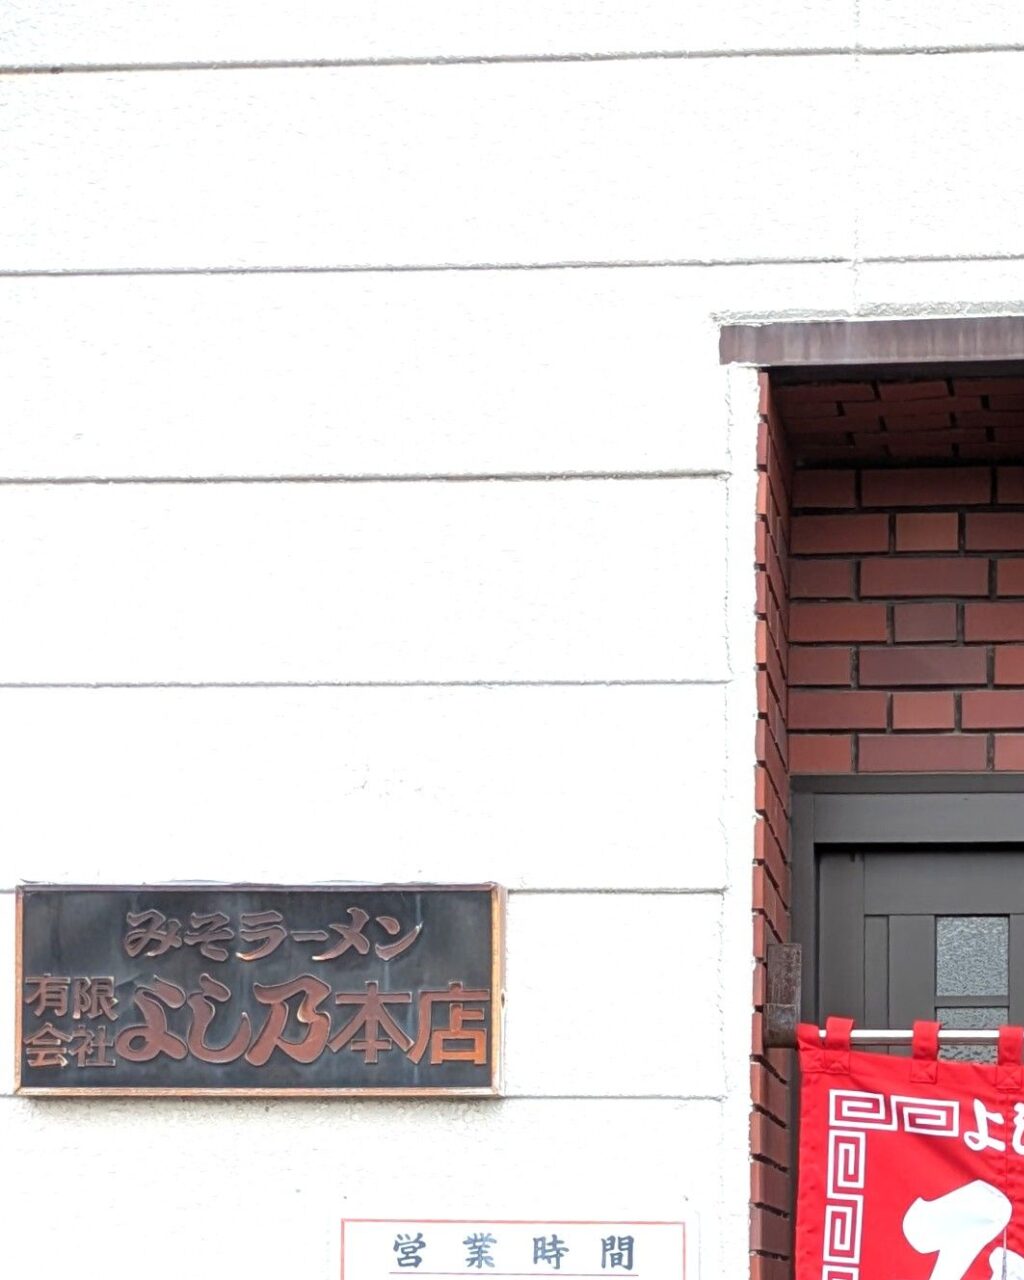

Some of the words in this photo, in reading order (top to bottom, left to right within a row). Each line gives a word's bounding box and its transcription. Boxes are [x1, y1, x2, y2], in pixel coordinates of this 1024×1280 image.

[126, 908, 423, 961] みそラーメン
[24, 972, 118, 1021] 有限
[115, 973, 490, 1066] よし乃本店
[24, 1023, 116, 1067] 会社
[393, 1233, 635, 1270] 営業時間
